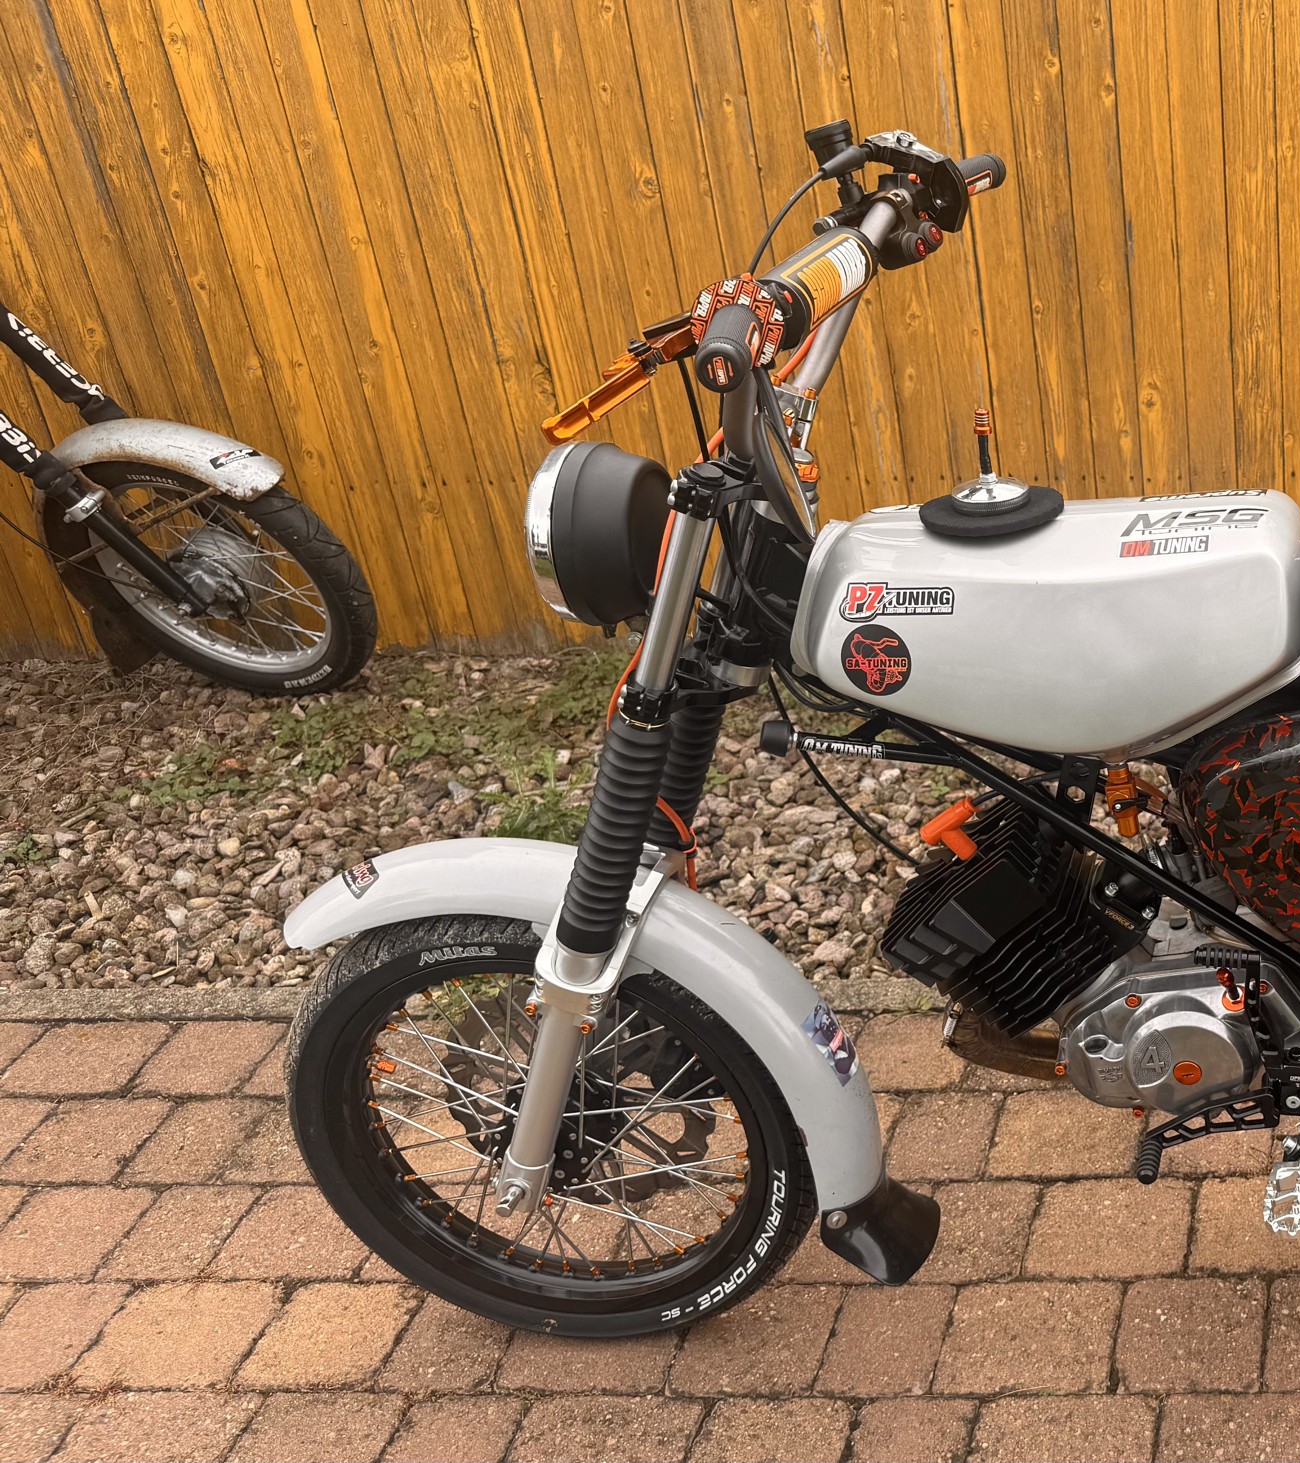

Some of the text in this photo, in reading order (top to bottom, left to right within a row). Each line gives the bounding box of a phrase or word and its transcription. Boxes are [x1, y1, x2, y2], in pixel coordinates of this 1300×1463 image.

[1120, 508, 1269, 537] MSG
[846, 657, 908, 670] SA-TUNING
[418, 945, 498, 966] Mitas
[1140, 1046, 1165, 1074] 4
[754, 1169, 786, 1257] TOURING
[696, 1254, 757, 1310] FORCE
[661, 1307, 681, 1321] SC
